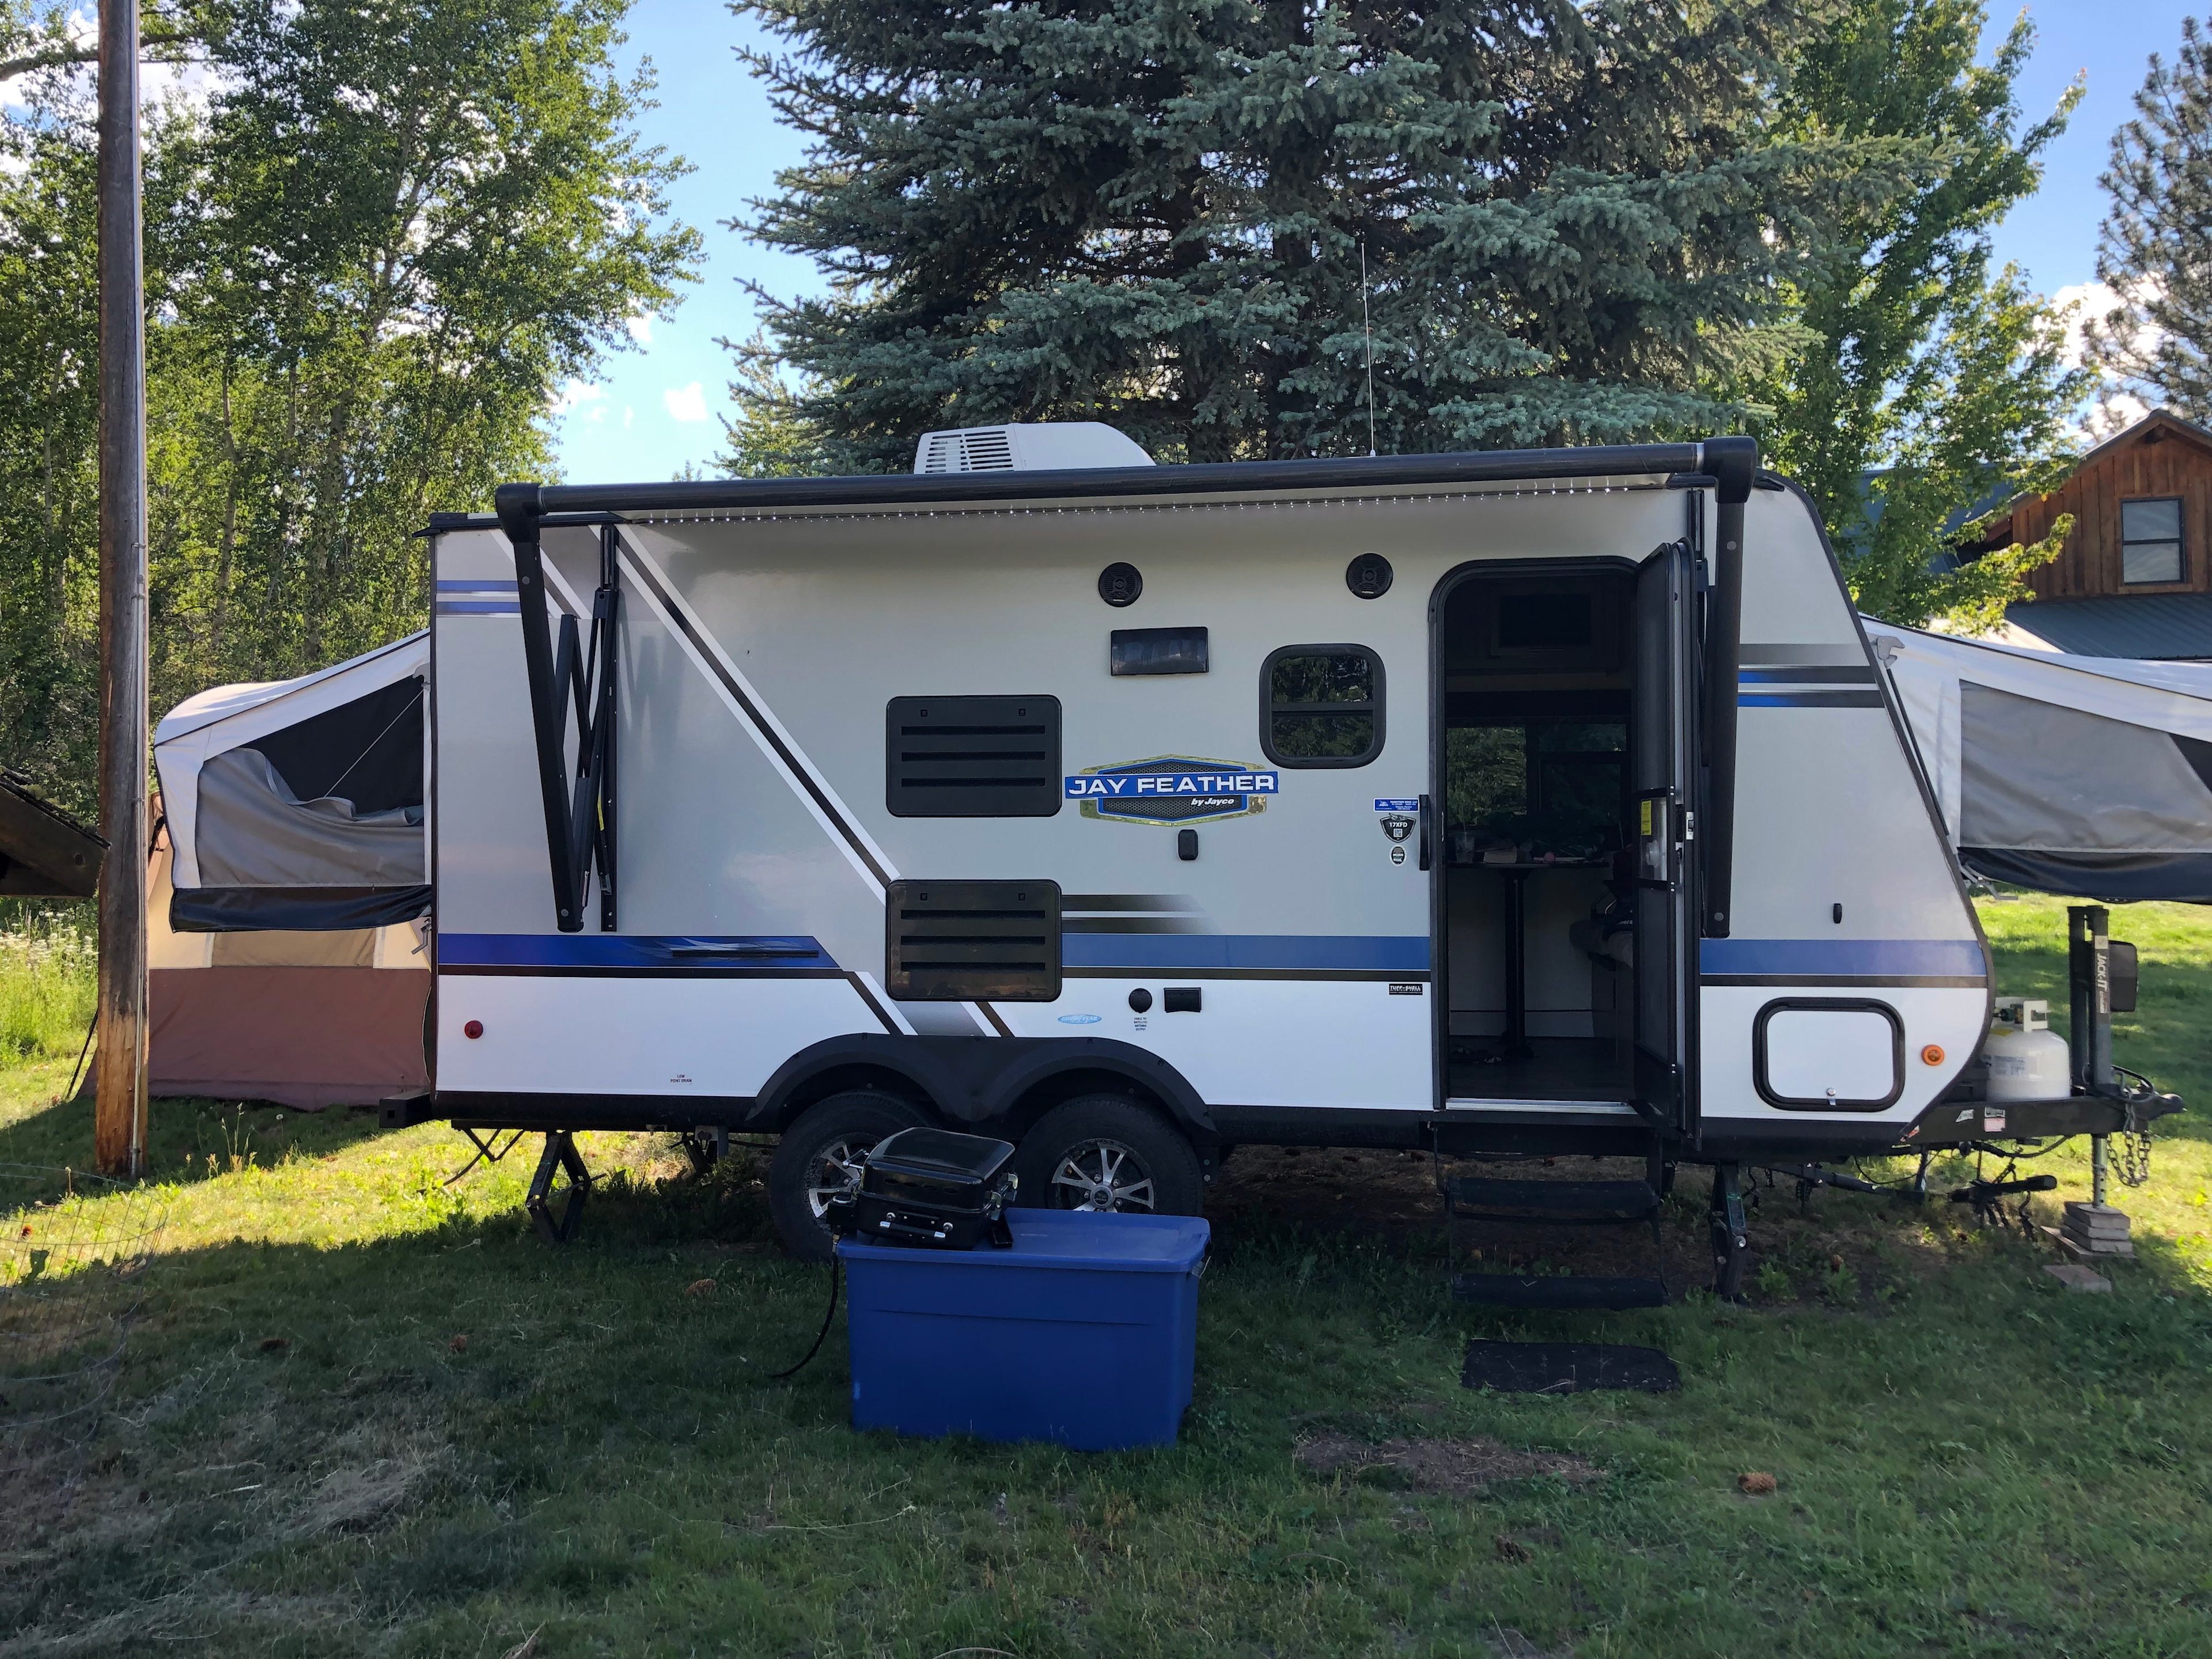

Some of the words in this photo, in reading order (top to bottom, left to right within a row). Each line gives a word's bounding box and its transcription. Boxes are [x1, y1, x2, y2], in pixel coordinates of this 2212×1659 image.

[1068, 778, 1127, 794] JAY
[1137, 775, 1274, 793] FEATHER
[1204, 798, 1234, 806] Jayco
[2097, 953, 2108, 992] JACK-IT
